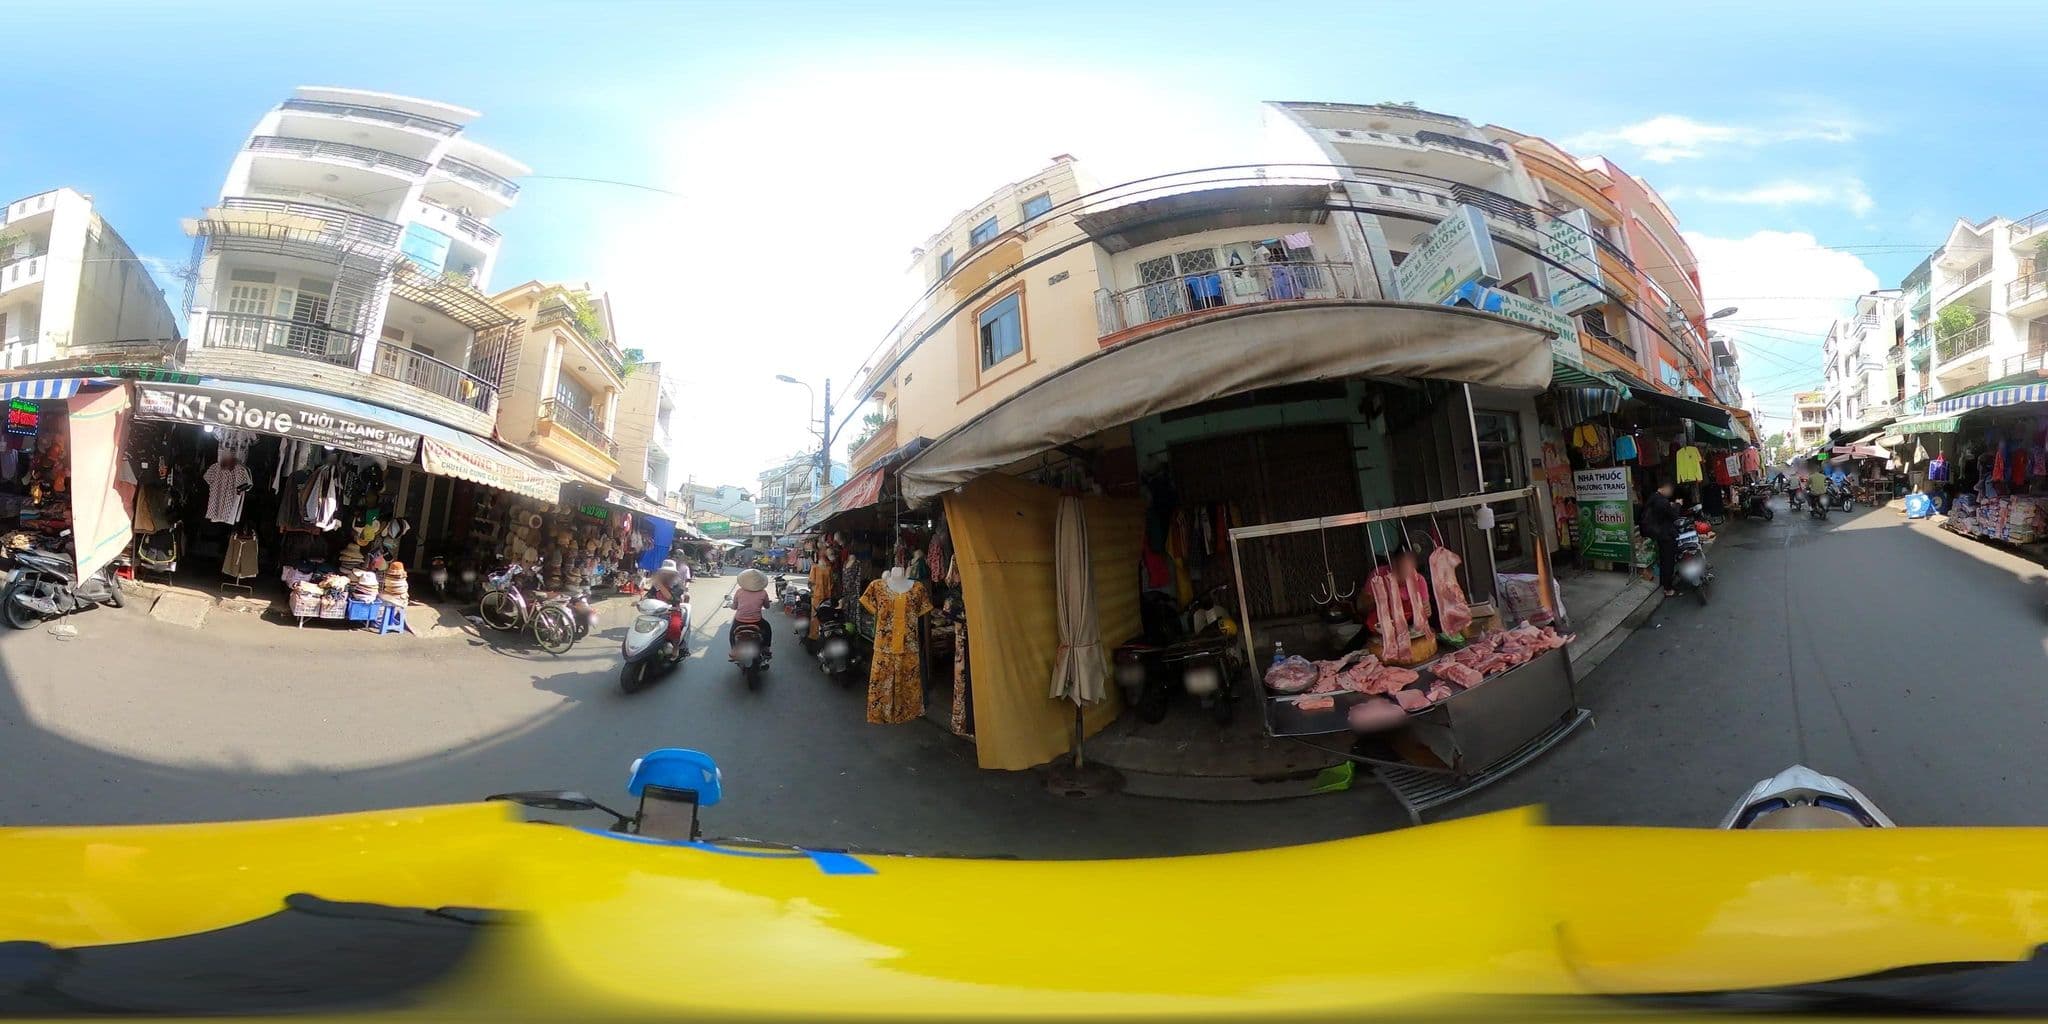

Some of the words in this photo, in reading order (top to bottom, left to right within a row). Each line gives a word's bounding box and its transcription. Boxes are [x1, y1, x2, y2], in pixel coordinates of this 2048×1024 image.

[176, 393, 211, 420] KT
[217, 398, 293, 433] Store
[338, 420, 385, 441] TRANG
[387, 433, 416, 449] NAM
[1595, 469, 1622, 480] THUỐC
[1604, 482, 1626, 490] TRANG
